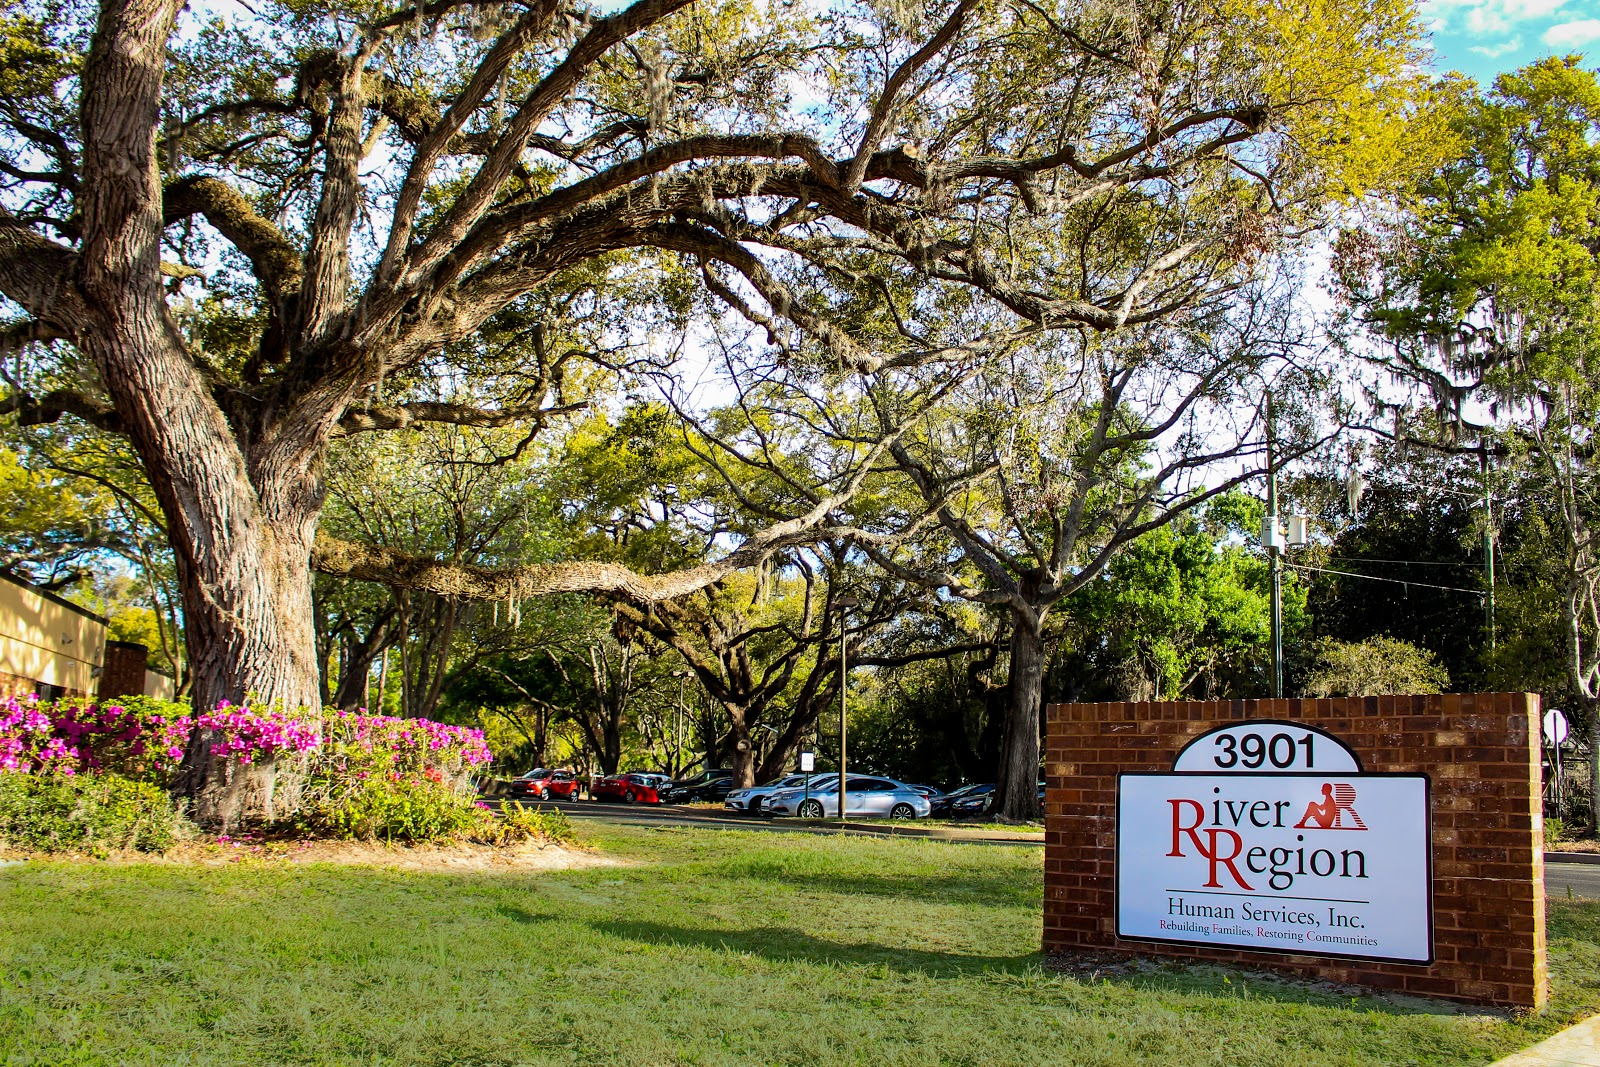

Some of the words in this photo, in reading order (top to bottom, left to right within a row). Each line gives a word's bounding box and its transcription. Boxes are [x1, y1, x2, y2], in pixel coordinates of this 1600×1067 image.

[1213, 733, 1314, 769] 3901
[1166, 787, 1290, 858] River
[1202, 828, 1369, 891] Region
[1167, 897, 1235, 920] Human
[1241, 901, 1320, 928] Services,
[1328, 907, 1365, 929] Inc.
[1159, 919, 1210, 936] Rebuilding
[1212, 923, 1254, 937] Families,
[1257, 926, 1304, 943] Restoring
[1306, 930, 1378, 947] Communities
